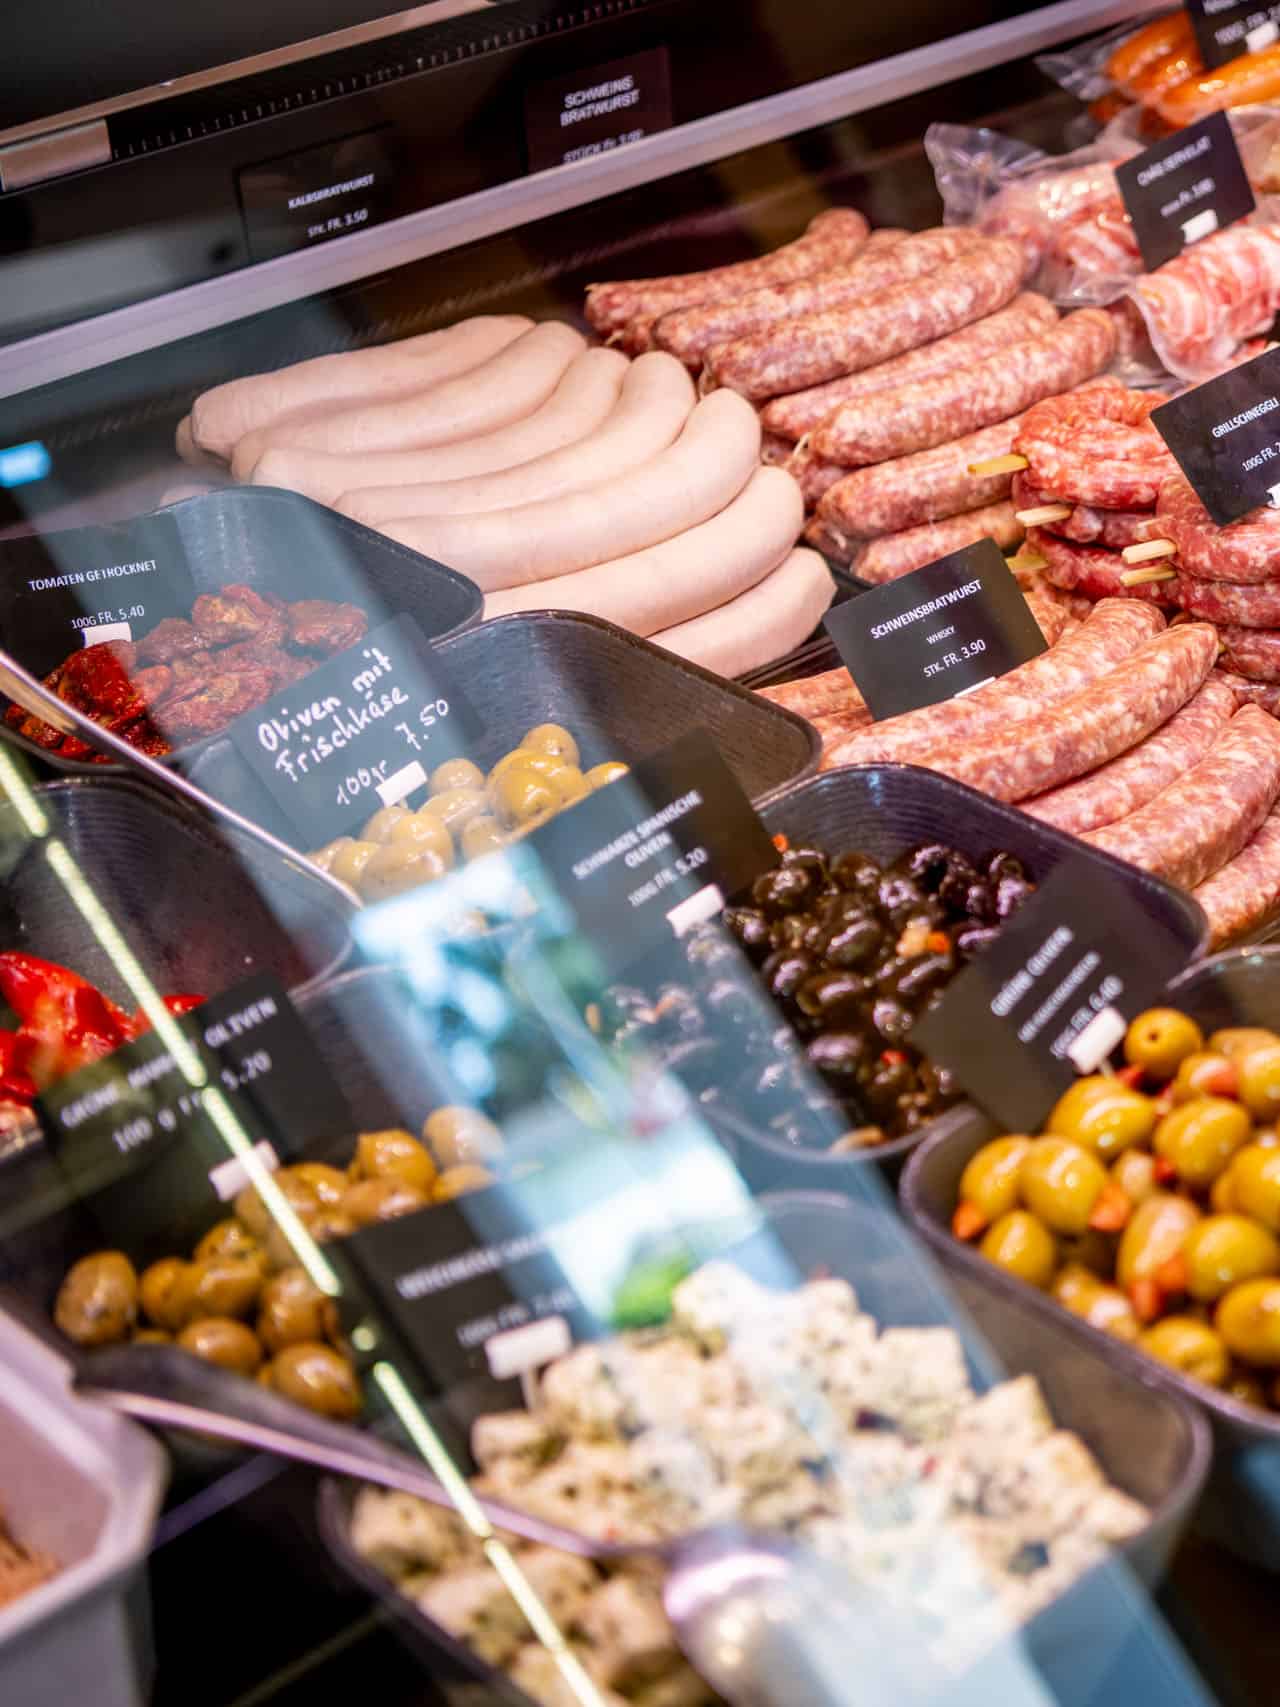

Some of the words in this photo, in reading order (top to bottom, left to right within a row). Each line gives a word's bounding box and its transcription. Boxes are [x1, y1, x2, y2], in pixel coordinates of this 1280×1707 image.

[559, 88, 641, 127] BRATWURST
[564, 75, 634, 109] SCHWEINS
[287, 173, 375, 209] KALBSBRATWURST
[344, 208, 369, 227] 3.50
[1211, 396, 1280, 438] GRILLSCHNEGGLI
[1260, 447, 1278, 461] FR.
[28, 571, 85, 592] TOMATEN
[86, 559, 157, 583] GETROCKNET
[71, 615, 97, 630] 100G
[98, 610, 117, 625] FR.
[119, 604, 145, 621] 5.40
[870, 579, 984, 640] SCHWEINSBRATWURST
[925, 624, 956, 645] WHISKY
[923, 660, 945, 678] STK.
[943, 652, 963, 668] FR.
[961, 639, 987, 659] 3.90
[258, 696, 341, 751] Oliven
[351, 646, 393, 693] mit
[394, 698, 449, 750] 7.50
[571, 829, 640, 880] SCHWARZE
[636, 789, 704, 840] SPANISCHE
[624, 830, 673, 869] OLIVEN
[675, 847, 708, 876] 5.20
[1026, 925, 1074, 977] OLIVEN
[203, 997, 278, 1048] OLIVEN
[112, 1117, 153, 1153] 100
